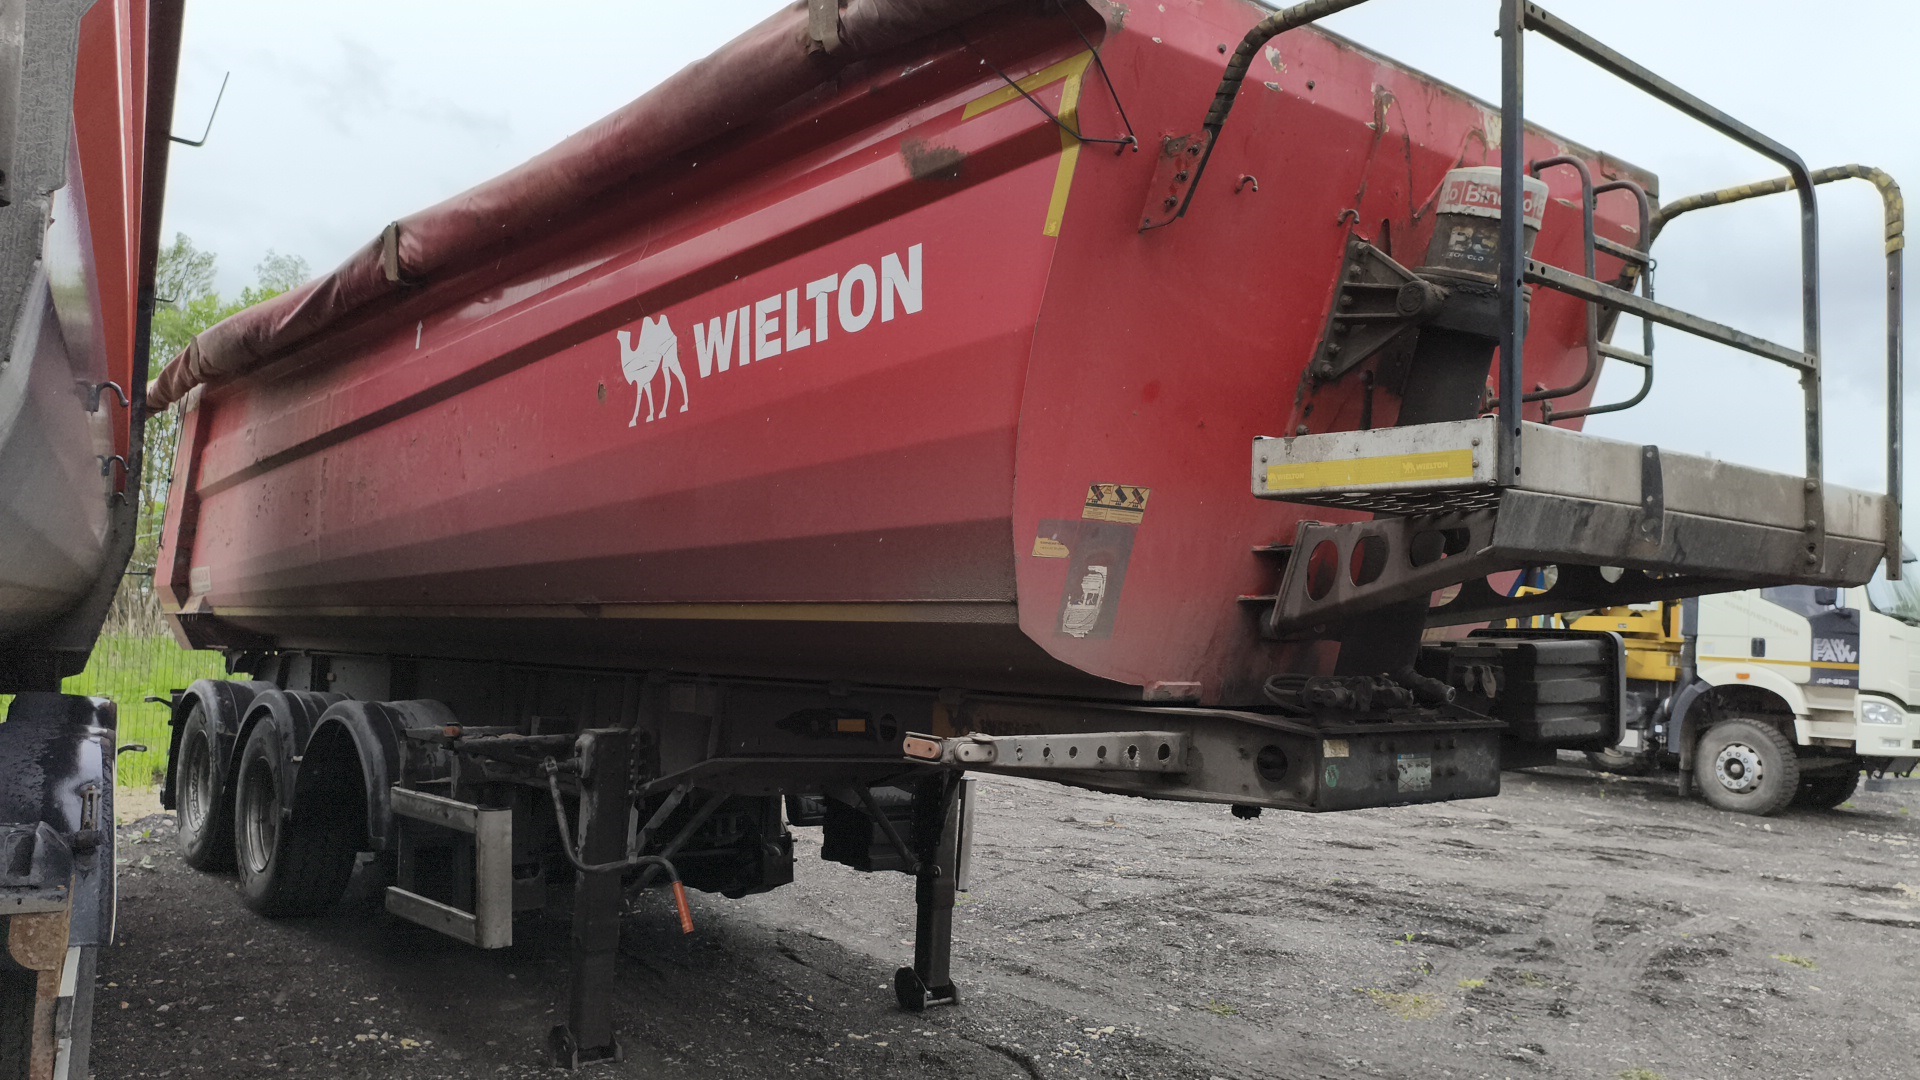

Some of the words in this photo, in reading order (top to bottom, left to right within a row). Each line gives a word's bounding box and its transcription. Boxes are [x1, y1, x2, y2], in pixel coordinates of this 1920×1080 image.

[693, 243, 923, 378] WIELTON
[1416, 461, 1449, 472] WIELTON
[1277, 472, 1305, 480] WIELTON
[1812, 650, 1857, 663] FAW
